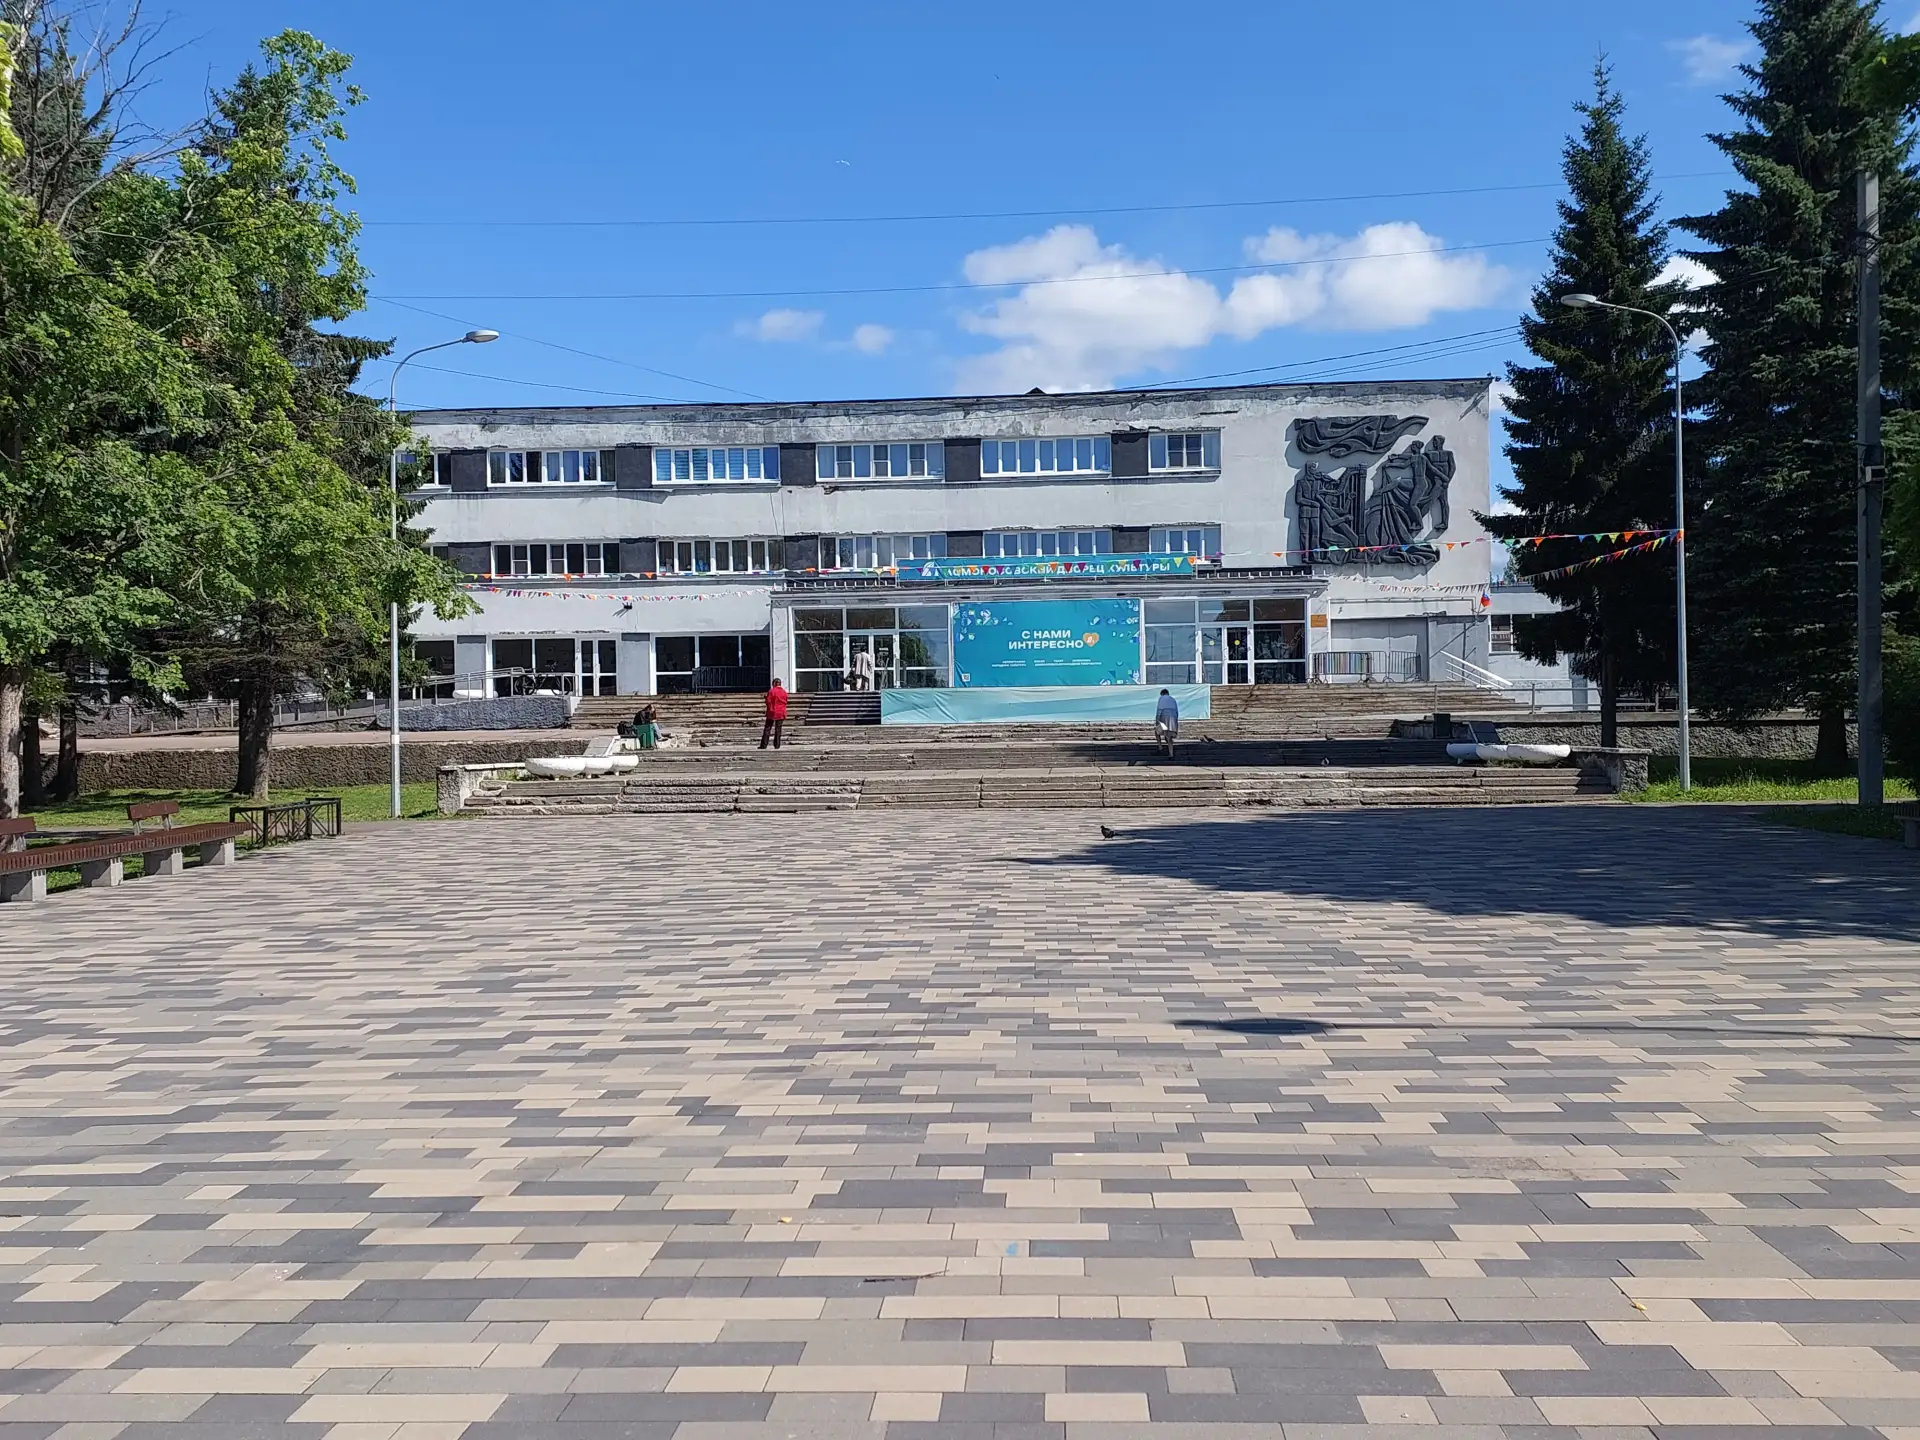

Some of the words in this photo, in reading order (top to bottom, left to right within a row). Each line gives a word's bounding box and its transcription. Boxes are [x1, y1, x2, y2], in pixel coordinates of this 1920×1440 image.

[1056, 564, 1105, 575] ДОРЕЦ
[1021, 630, 1031, 639] С
[1034, 629, 1071, 639] НАМИ
[1008, 639, 1084, 650] ИНТЕРЕСНО
